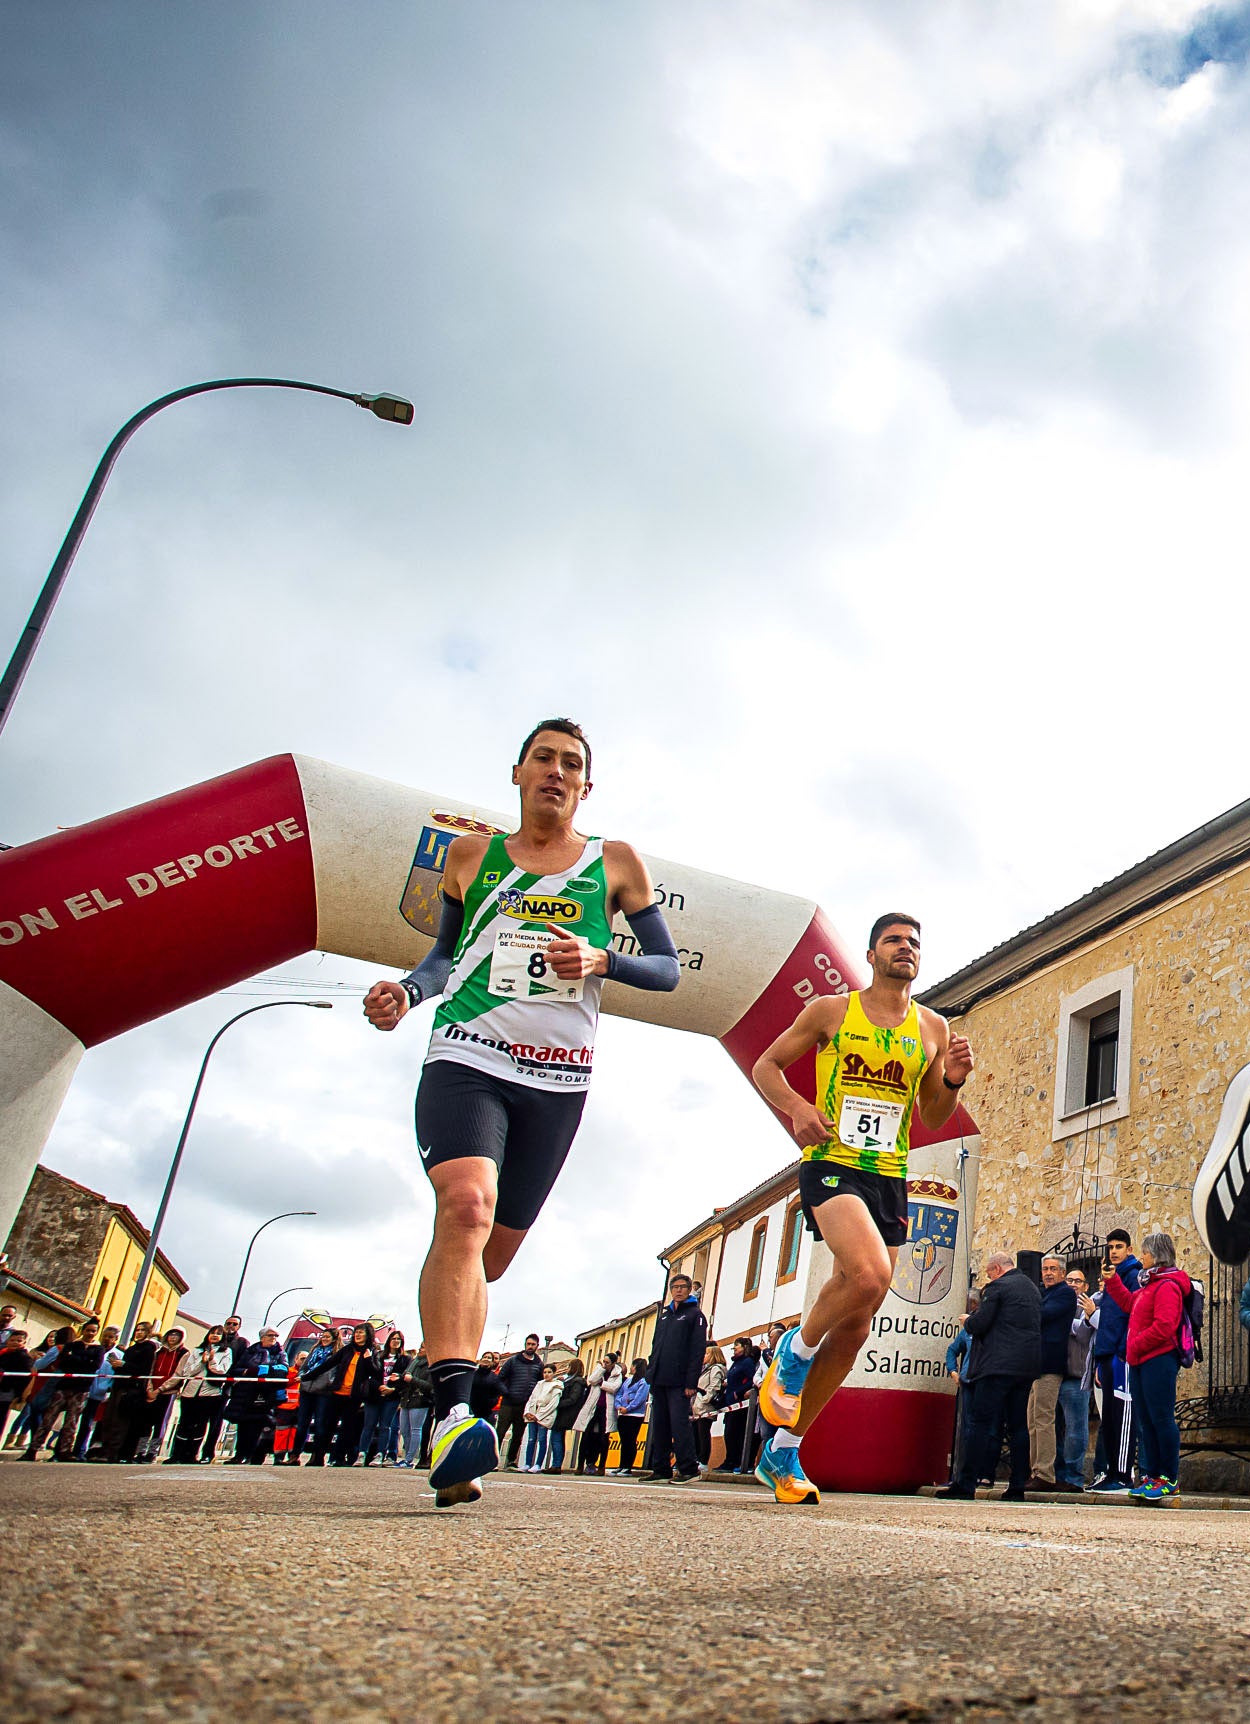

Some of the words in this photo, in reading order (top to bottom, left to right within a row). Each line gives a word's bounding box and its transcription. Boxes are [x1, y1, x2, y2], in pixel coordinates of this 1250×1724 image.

[63, 888, 124, 920] EL
[126, 817, 305, 898] DEPORTE
[521, 900, 577, 918] NAPO
[527, 952, 547, 979] 8
[857, 1114, 880, 1135] 51
[871, 1315, 960, 1339] iputación
